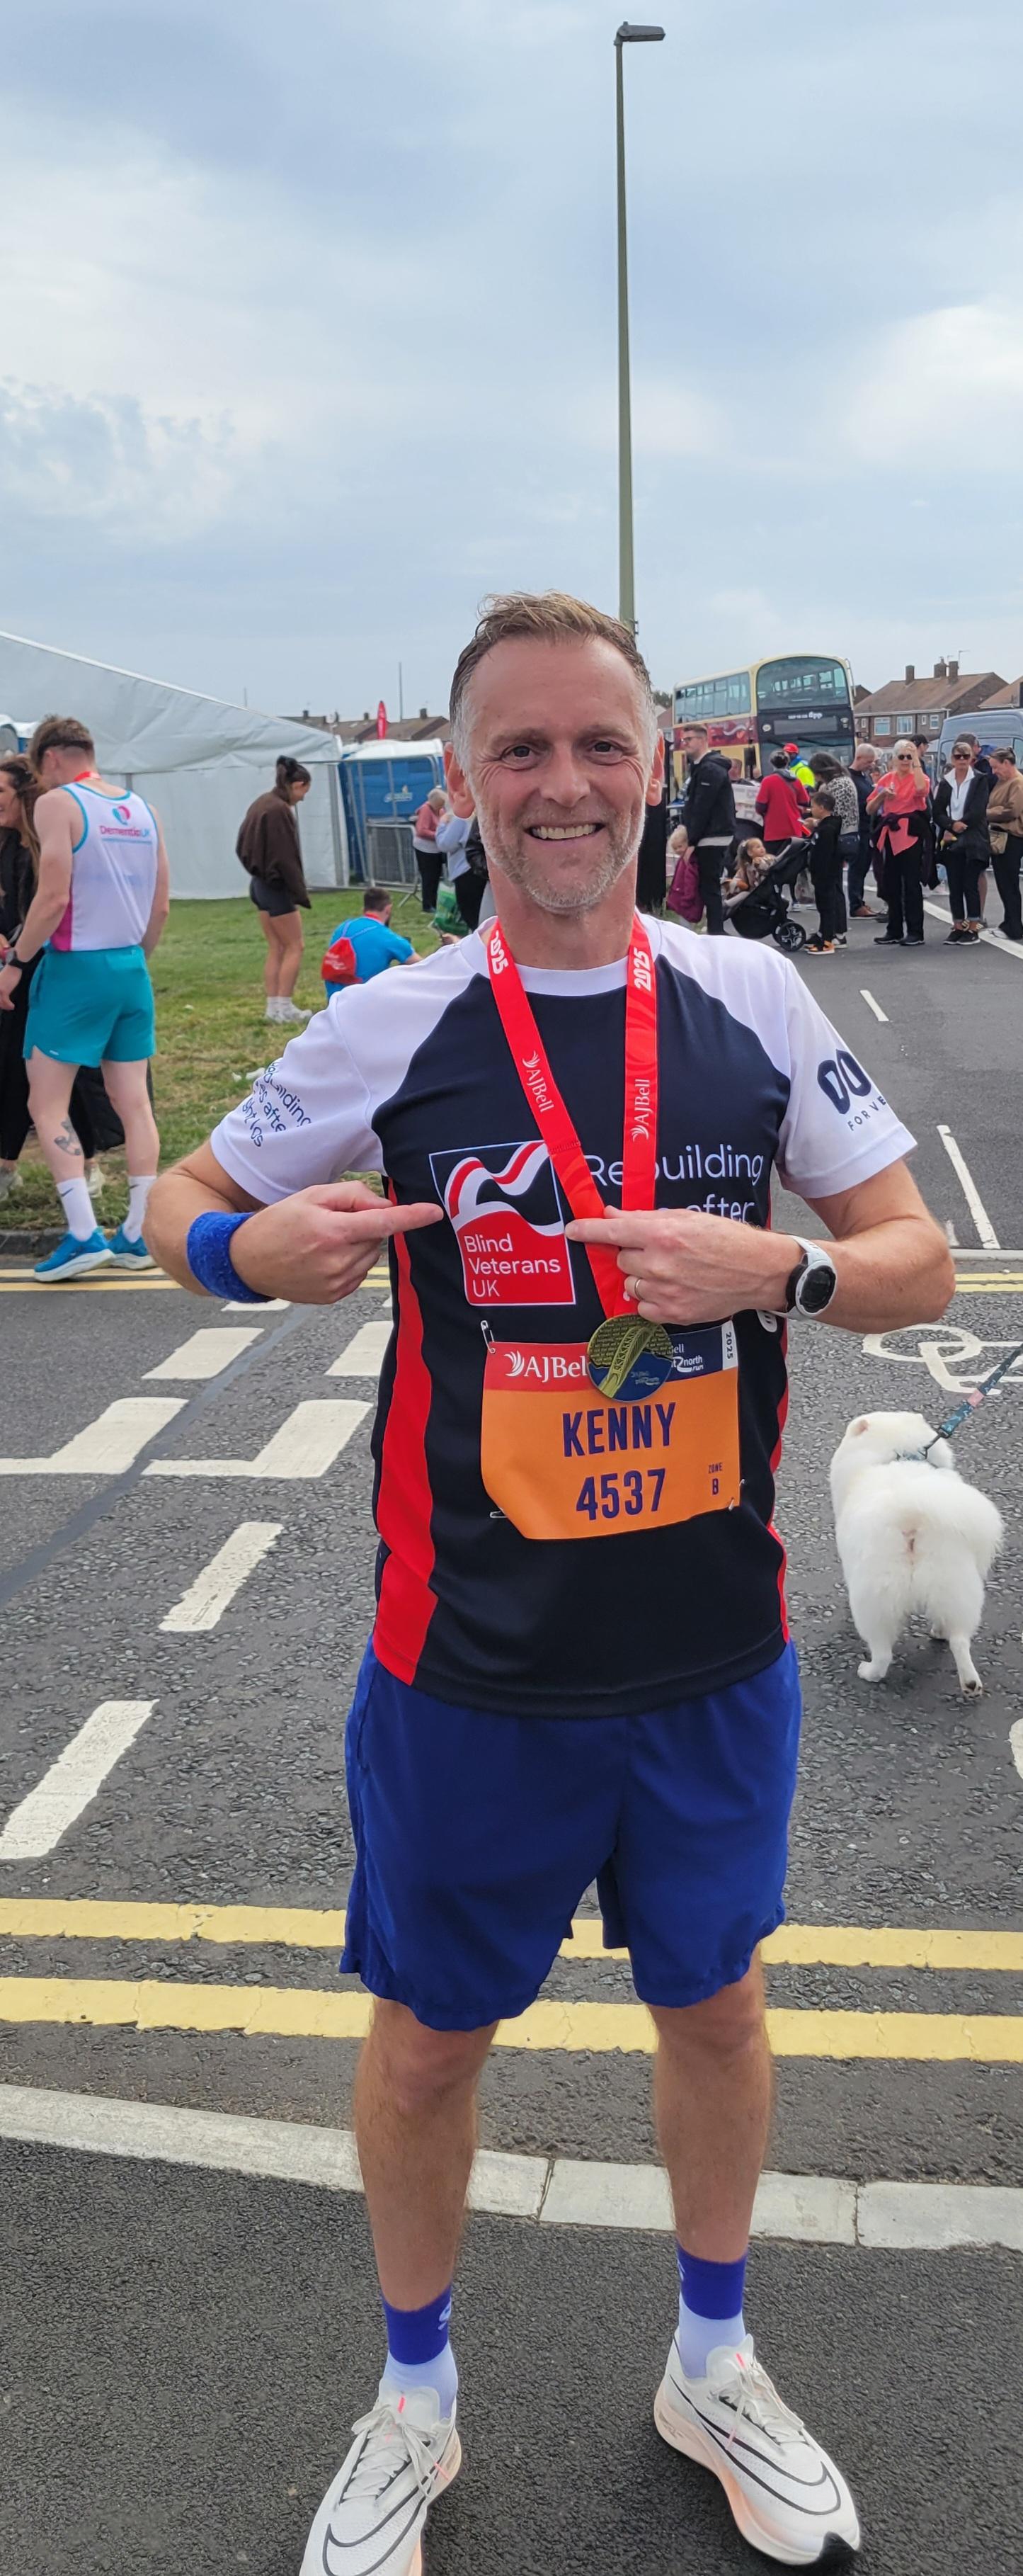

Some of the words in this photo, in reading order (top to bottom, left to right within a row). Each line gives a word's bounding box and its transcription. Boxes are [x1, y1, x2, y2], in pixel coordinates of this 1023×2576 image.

[491, 929, 509, 975] 2025
[633, 946, 651, 992] 2025
[263, 1102, 286, 1132] afte
[847, 1110, 871, 1131] FOR
[869, 1096, 886, 1111] VE
[584, 1144, 764, 1186] Reuilding
[464, 1233, 513, 1252] Blind
[468, 1257, 561, 1275] Veterans
[472, 1279, 501, 1298] UK
[671, 1343, 685, 1354] ell
[683, 1354, 703, 1366] north
[524, 1355, 588, 1383] AJBel
[562, 1402, 676, 1457] KENNY
[708, 1462, 723, 1474] ZONE
[576, 1468, 665, 1521] 4537
[711, 1478, 719, 1496] B
